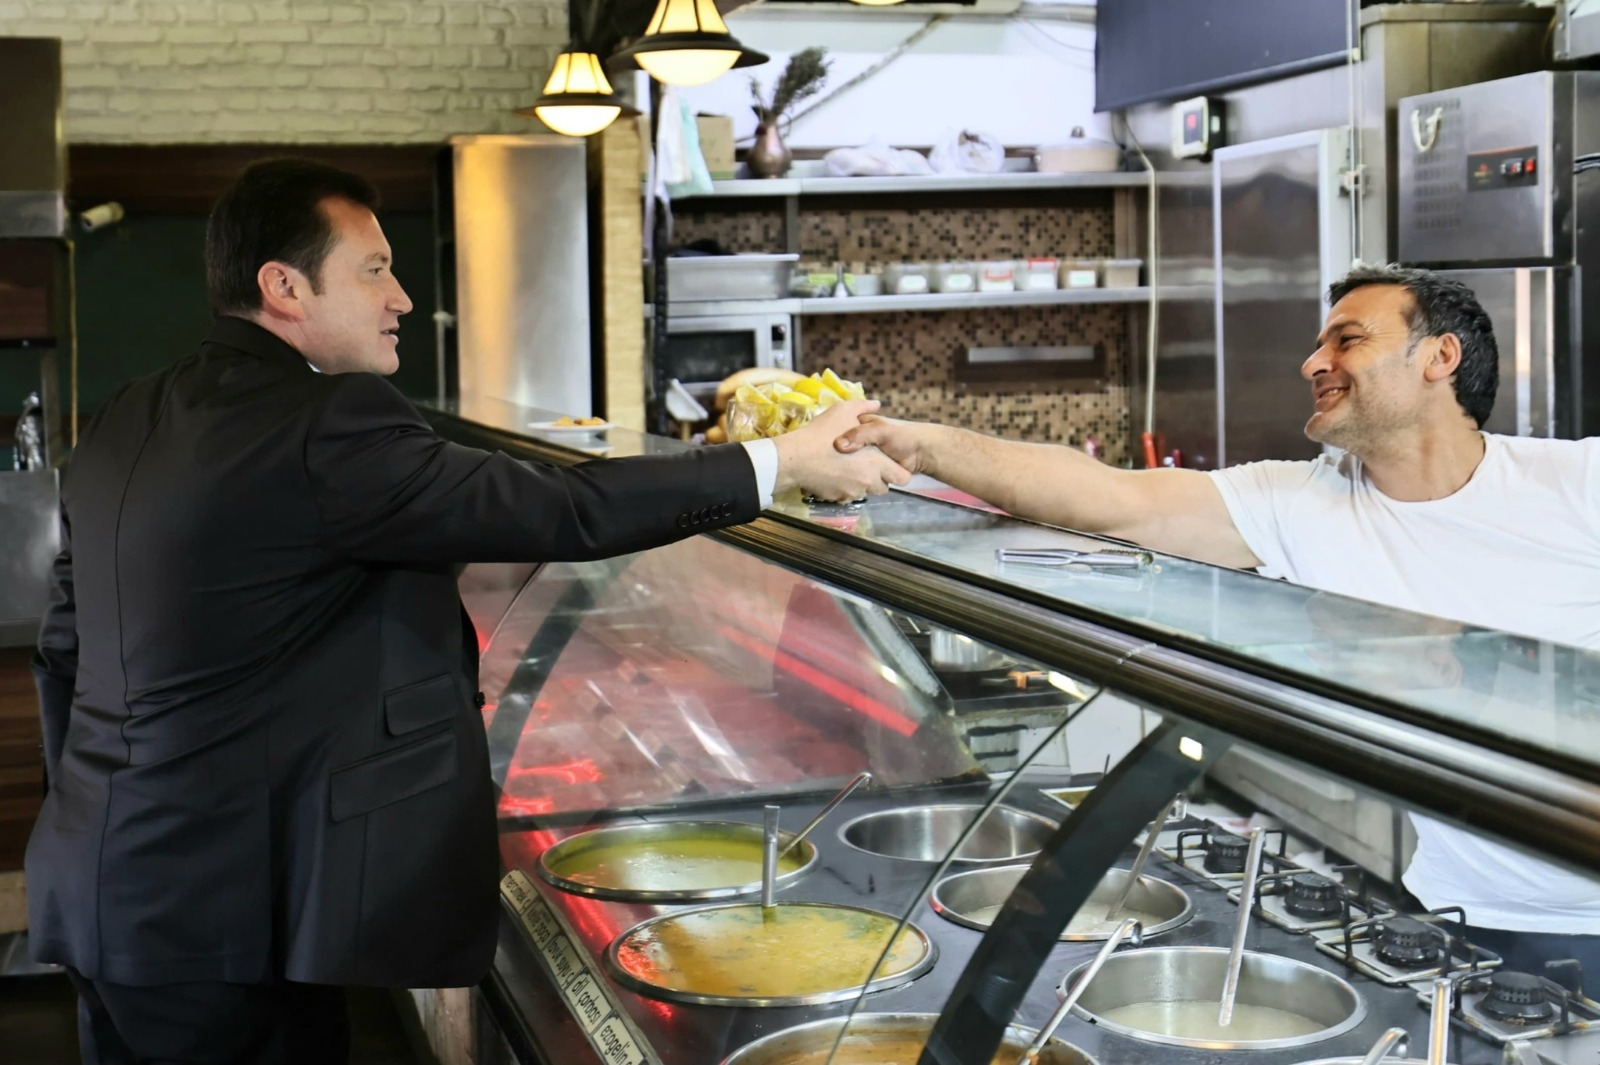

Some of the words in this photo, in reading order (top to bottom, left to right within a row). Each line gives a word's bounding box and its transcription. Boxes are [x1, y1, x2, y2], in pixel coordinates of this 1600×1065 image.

[503, 874, 530, 904] mercimek
[555, 956, 573, 977] suyu
[571, 976, 590, 997] dil
[574, 991, 602, 1026] çorbası
[600, 1024, 631, 1065] ezogelin
